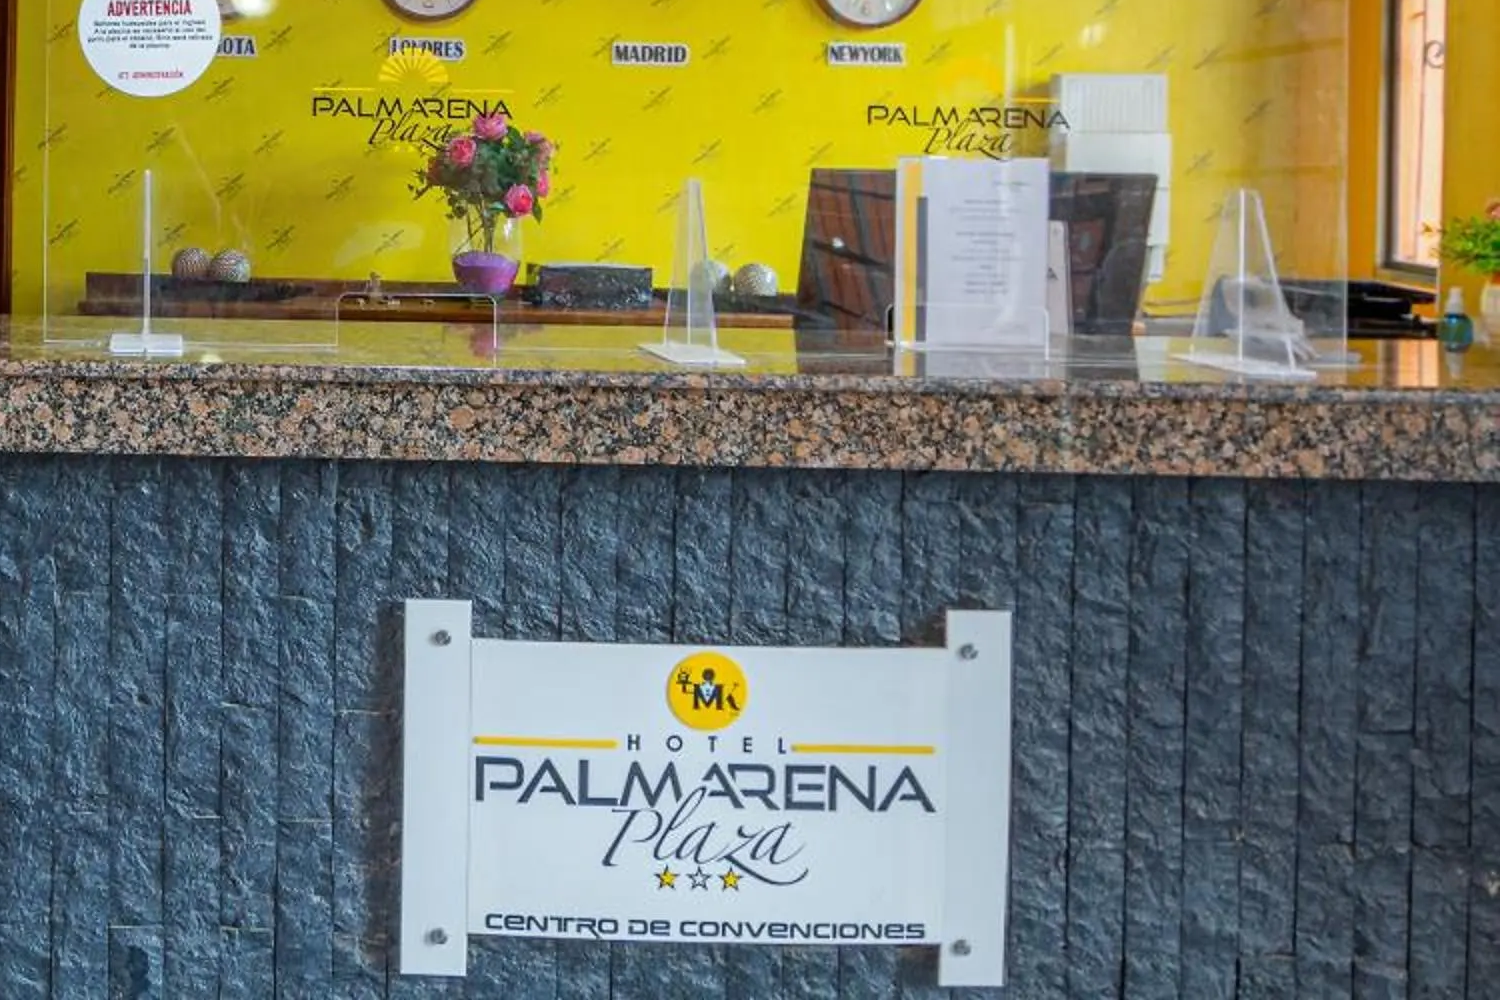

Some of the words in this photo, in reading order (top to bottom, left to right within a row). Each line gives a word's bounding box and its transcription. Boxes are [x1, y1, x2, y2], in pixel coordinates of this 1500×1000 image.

[107, 0, 193, 16] ADVERTENCIA
[216, 37, 256, 55] OTA
[613, 44, 687, 63] MADRID
[829, 45, 903, 62] NEWYORK
[311, 96, 513, 120] PALMARENA
[867, 105, 1071, 129] PALMARENA
[367, 112, 453, 151] Plaza
[924, 119, 1013, 162] Plaza
[626, 732, 789, 756] HOTEL
[474, 755, 937, 813] PALMARENA
[601, 785, 810, 887] Plaza
[483, 911, 620, 939] CENTRO
[627, 917, 671, 938] DE
[679, 918, 927, 942] CONVENCIONES
